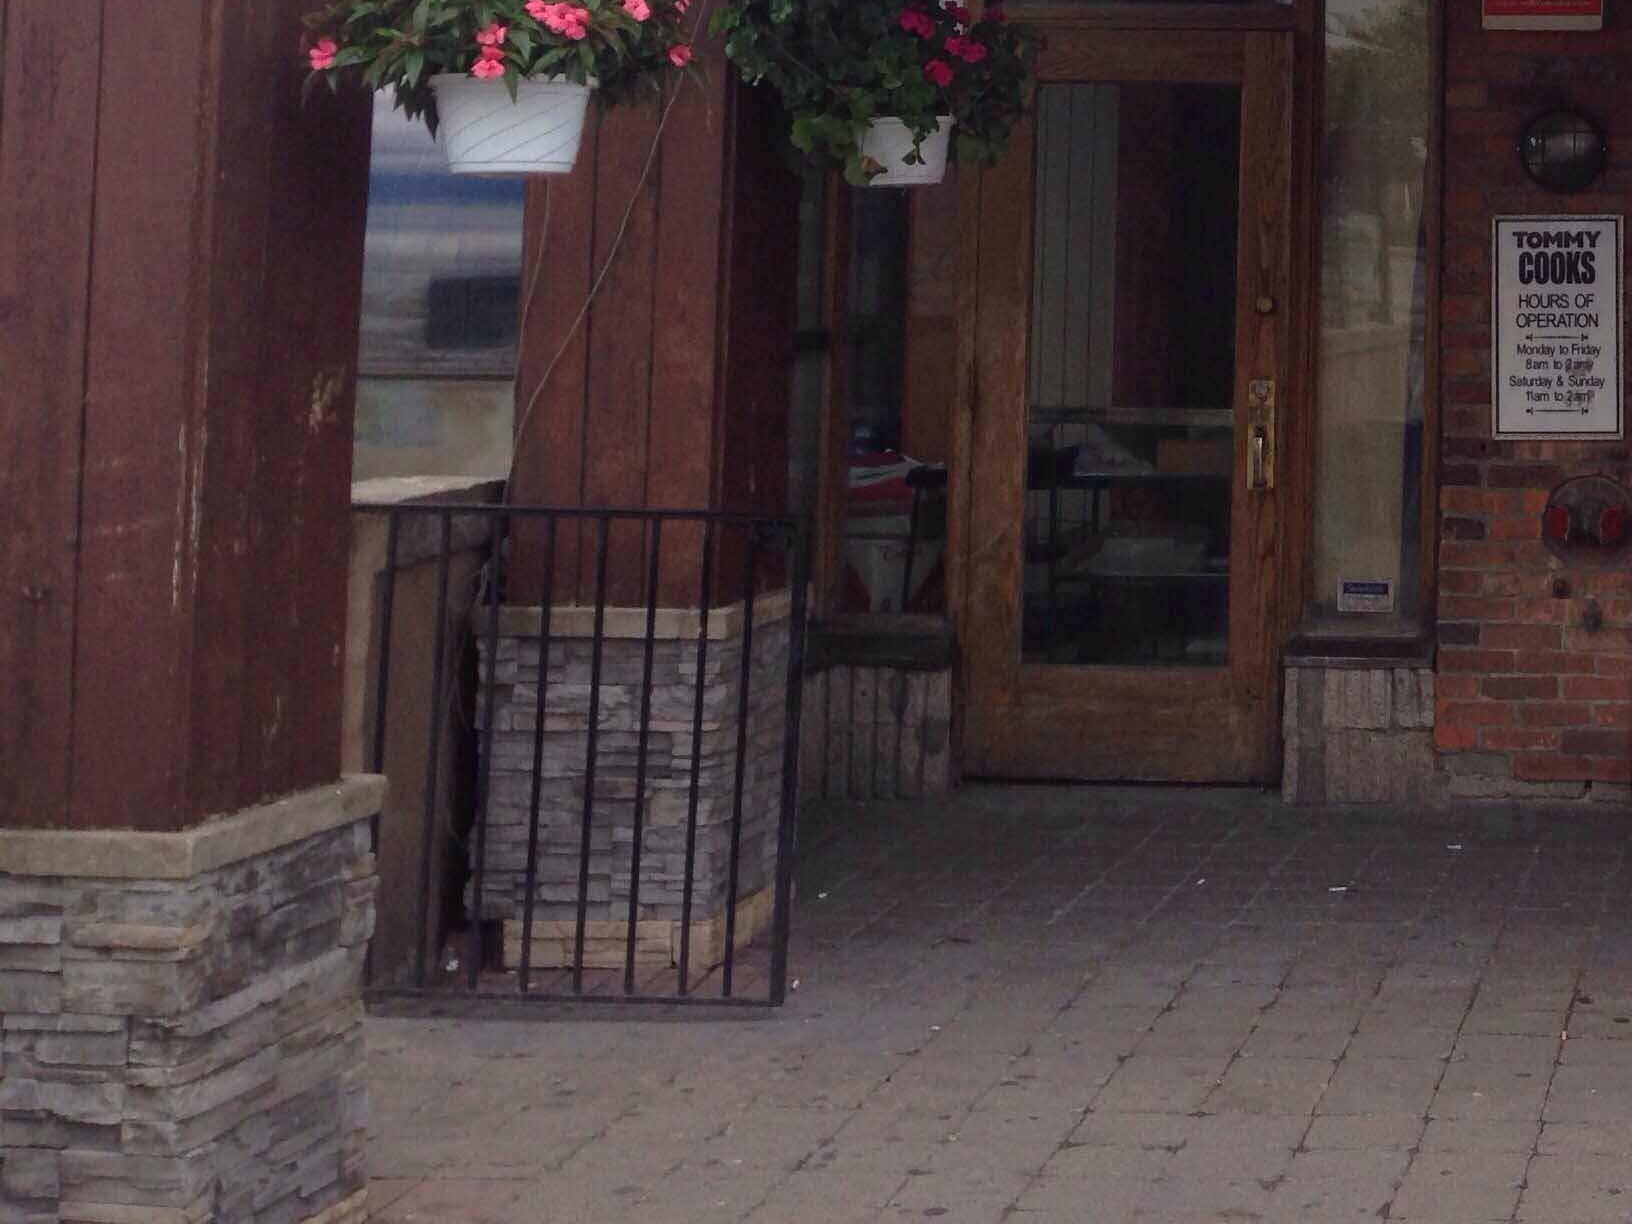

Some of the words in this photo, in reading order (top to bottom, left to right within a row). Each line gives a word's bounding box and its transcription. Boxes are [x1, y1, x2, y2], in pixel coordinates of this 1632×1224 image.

[1512, 231, 1601, 249] TOMMY
[1518, 251, 1595, 285] COOKS
[1519, 293, 1569, 309] HOURS
[1574, 293, 1594, 308] OF
[1515, 313, 1598, 328] OPERATION
[1516, 344, 1555, 357] Monday
[1559, 344, 1568, 355] to
[1571, 344, 1601, 357] Friday
[1553, 359, 1563, 370] to
[1509, 376, 1552, 389] Saturday
[1556, 375, 1564, 387] &
[1568, 376, 1605, 389] Sunday
[1554, 391, 1563, 402] to
